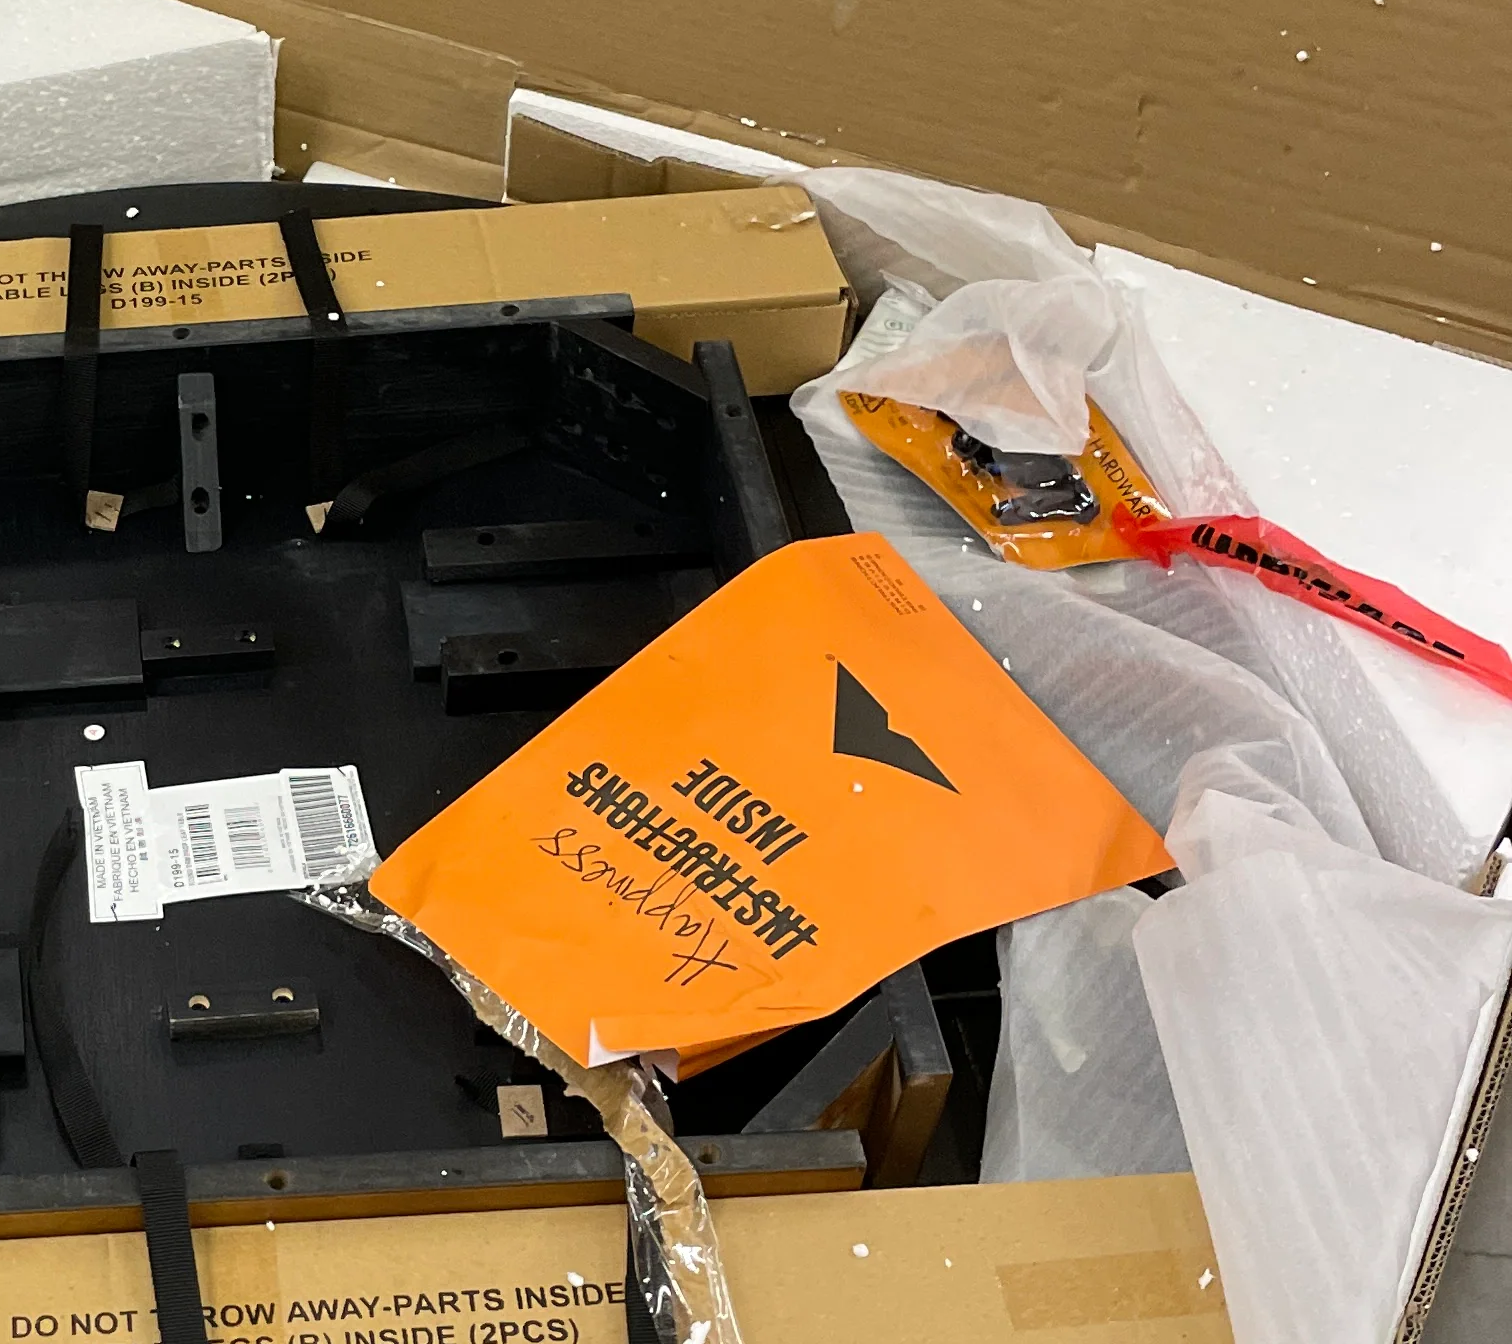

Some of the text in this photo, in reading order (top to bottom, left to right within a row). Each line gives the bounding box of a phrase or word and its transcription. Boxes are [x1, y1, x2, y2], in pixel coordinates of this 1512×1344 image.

[37, 266, 125, 283] THW
[132, 256, 286, 276] AWAY-PARTS
[111, 293, 203, 310] D199-15
[132, 281, 163, 296] (B)
[172, 274, 250, 290] INSIDE
[259, 268, 336, 287] (2P)
[1088, 438, 1152, 519] HARDWAR
[88, 796, 106, 889] MADE IN VIETNAM
[102, 782, 123, 902] FABRIQUE EN VIETNAM
[118, 788, 139, 893] HECHO EN VIETNAM
[671, 758, 810, 866] INSIDE
[529, 828, 738, 986] Happiness
[566, 762, 819, 960] INSTRUCTIONS
[11, 1281, 626, 1339] DO NOT ROW AWAY-PARTS INSIDE
